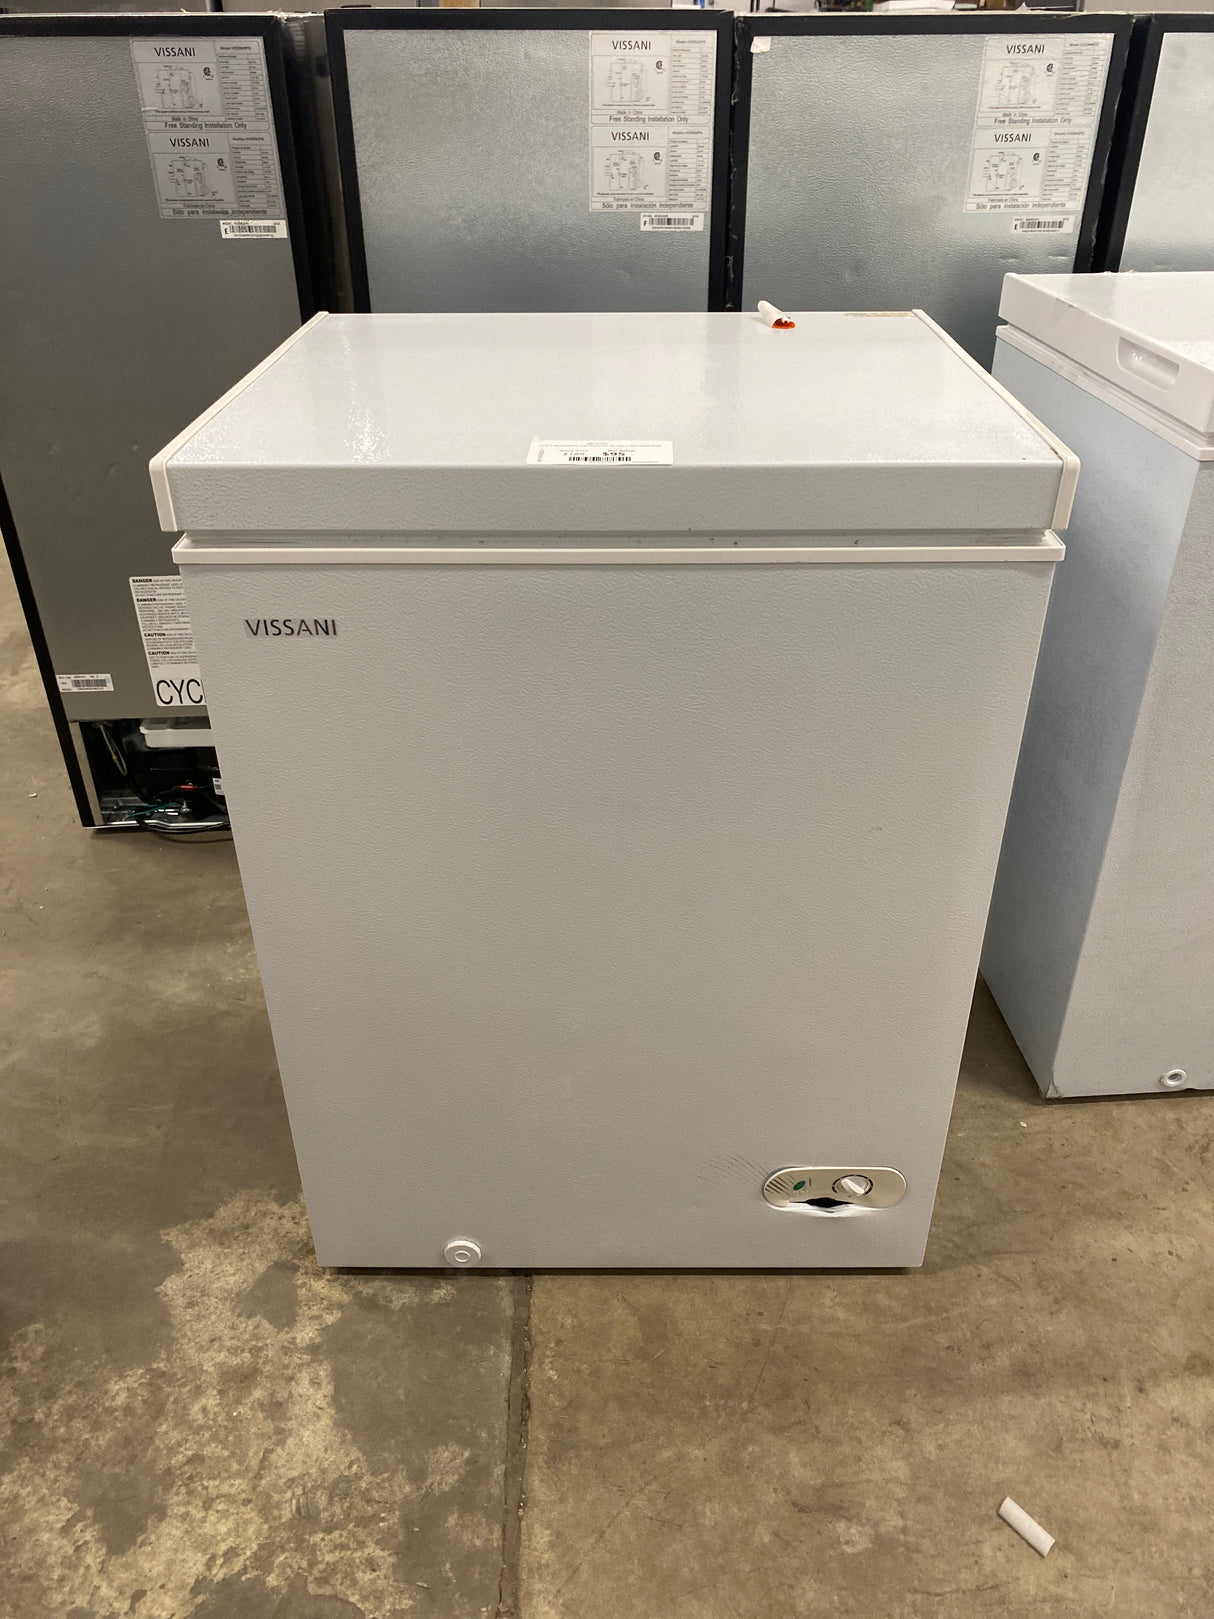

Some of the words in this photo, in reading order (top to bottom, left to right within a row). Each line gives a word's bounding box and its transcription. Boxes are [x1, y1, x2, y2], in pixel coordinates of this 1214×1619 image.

[612, 40, 651, 50] VISSANI
[1006, 44, 1045, 54] VISSANI
[154, 47, 196, 57] VISSANI
[1060, 117, 1072, 125] Only
[612, 131, 650, 141] VISSANI
[994, 133, 1032, 142] VISSANI
[170, 138, 210, 148] VISSANI
[245, 618, 338, 636] VISSANI
[156, 679, 206, 705] CYC
